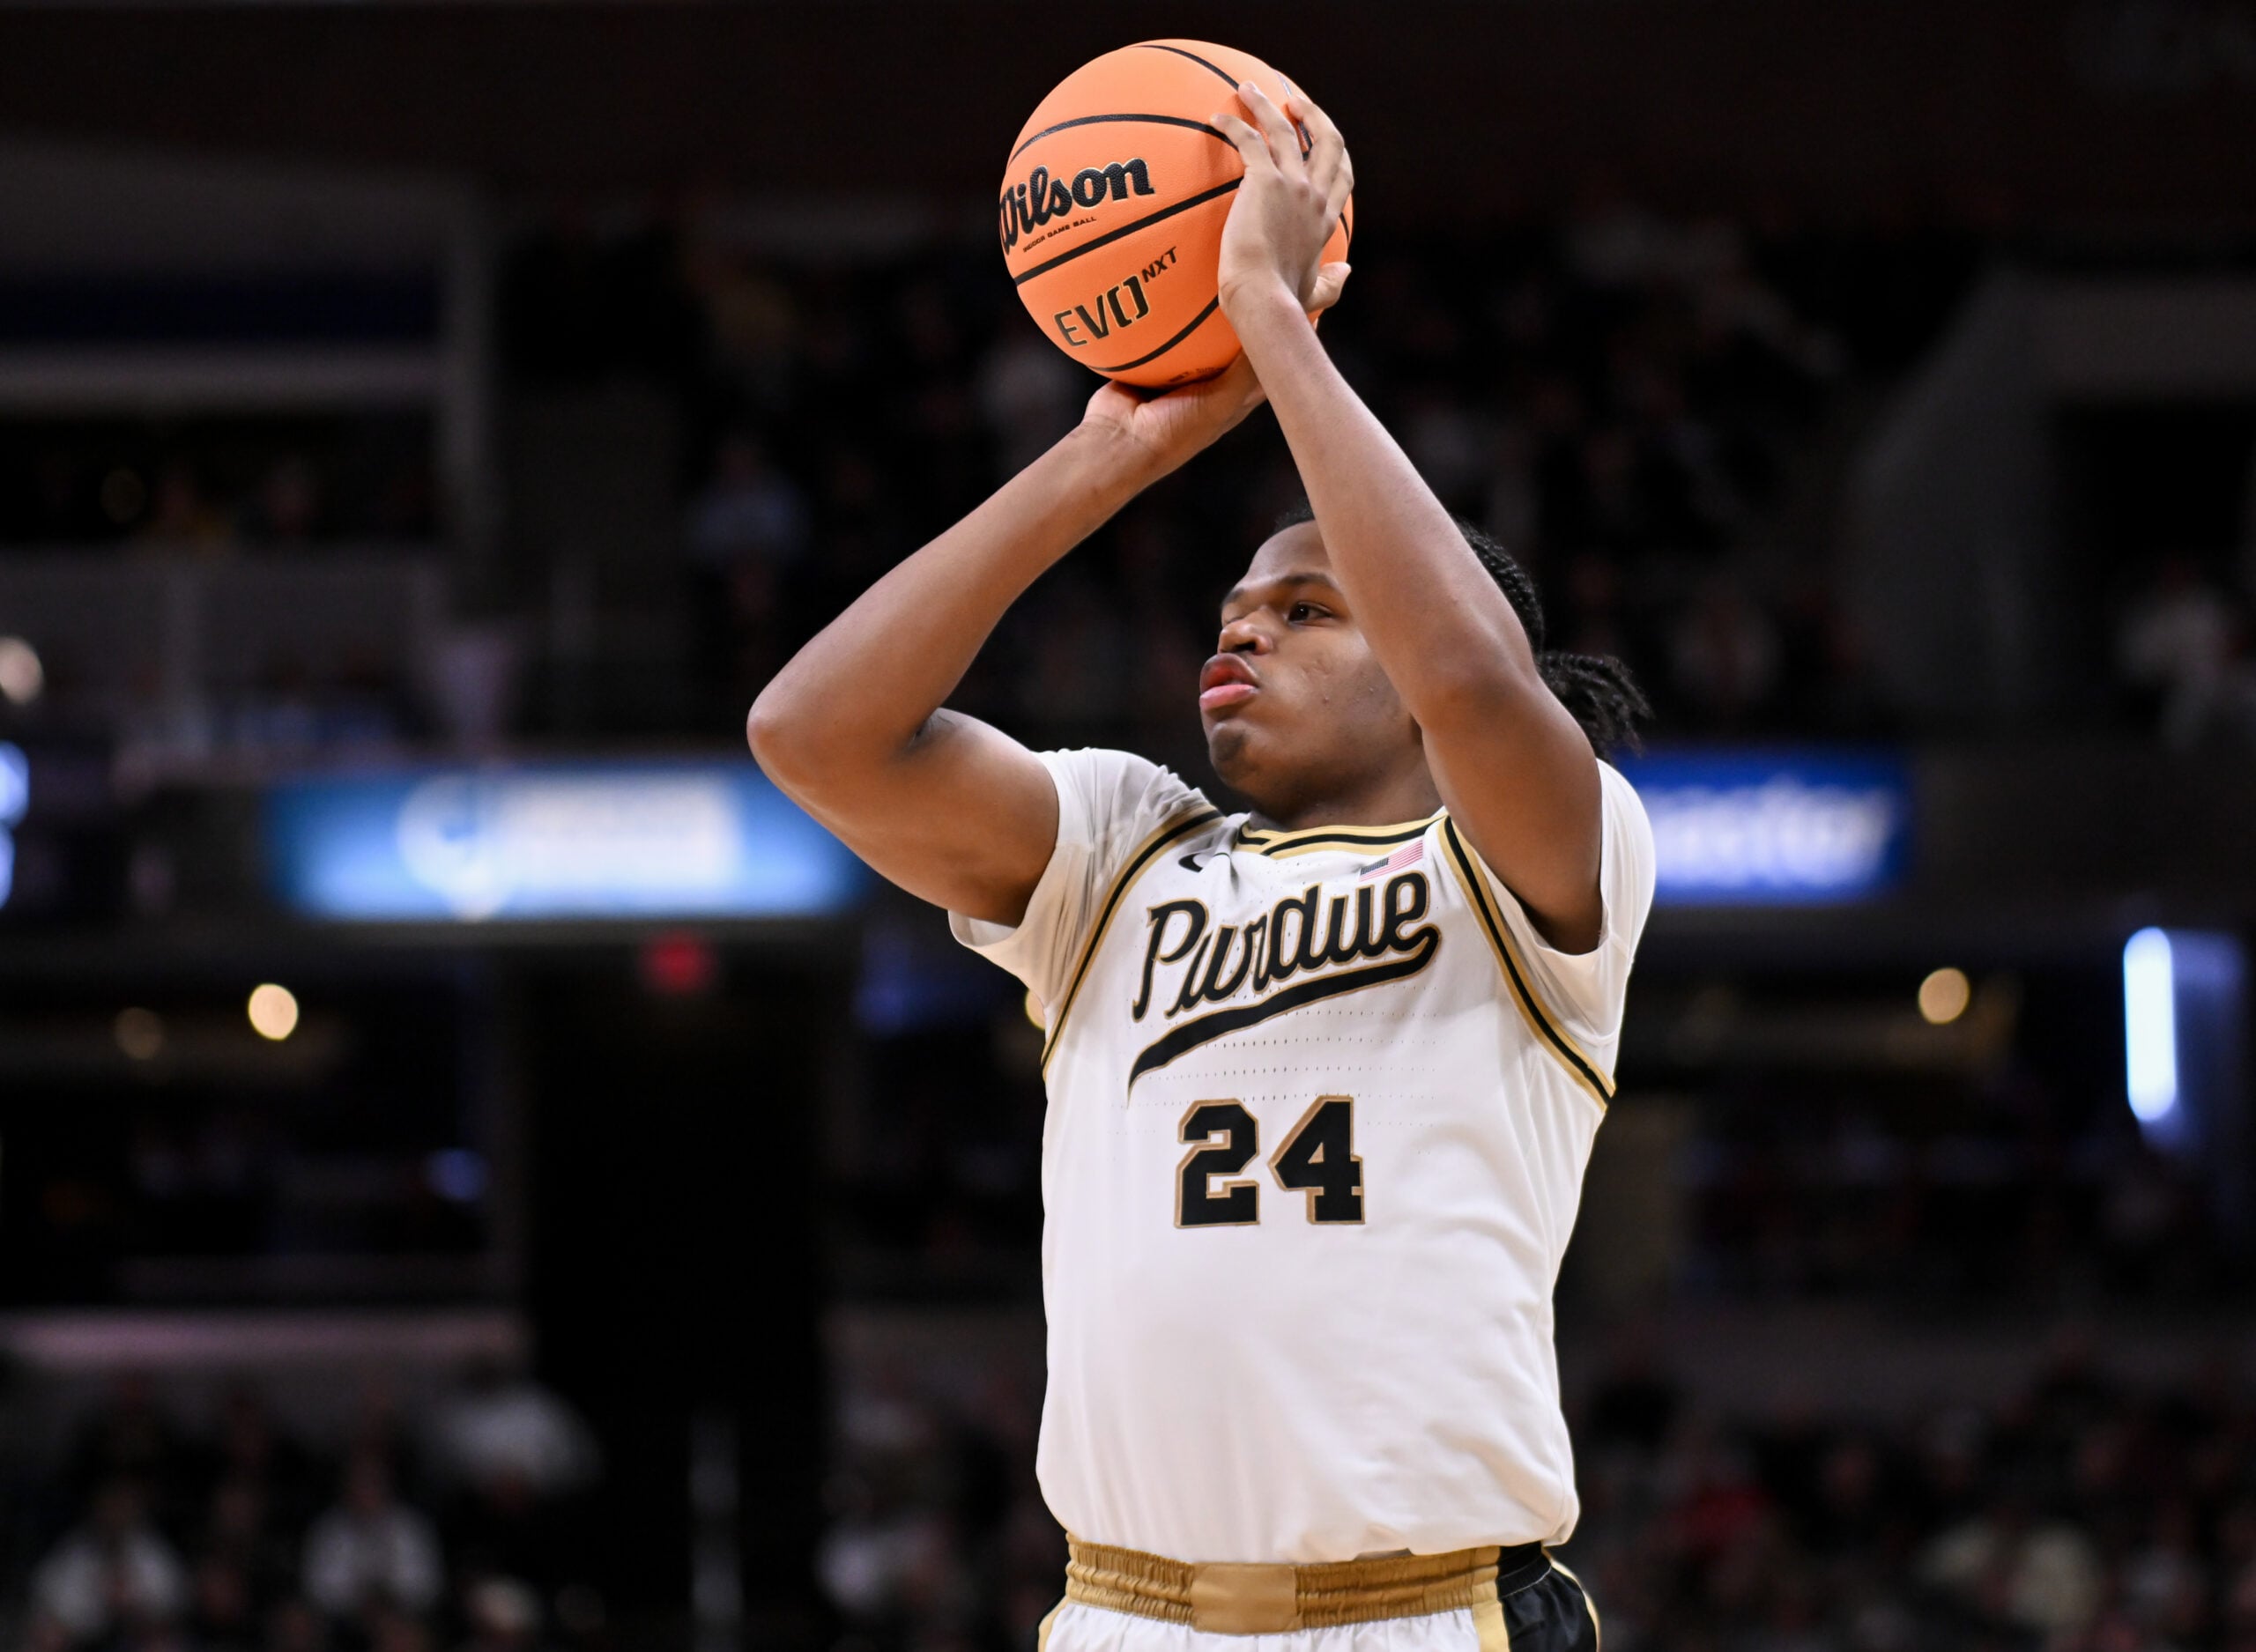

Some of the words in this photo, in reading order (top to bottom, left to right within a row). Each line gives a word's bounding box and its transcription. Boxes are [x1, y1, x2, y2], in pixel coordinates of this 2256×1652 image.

[1047, 224, 1071, 238] GAME
[1072, 216, 1097, 228] BALL
[1141, 246, 1177, 284] NXT
[1131, 870, 1432, 1023] Purdue
[1174, 1095, 1365, 1228] 24
